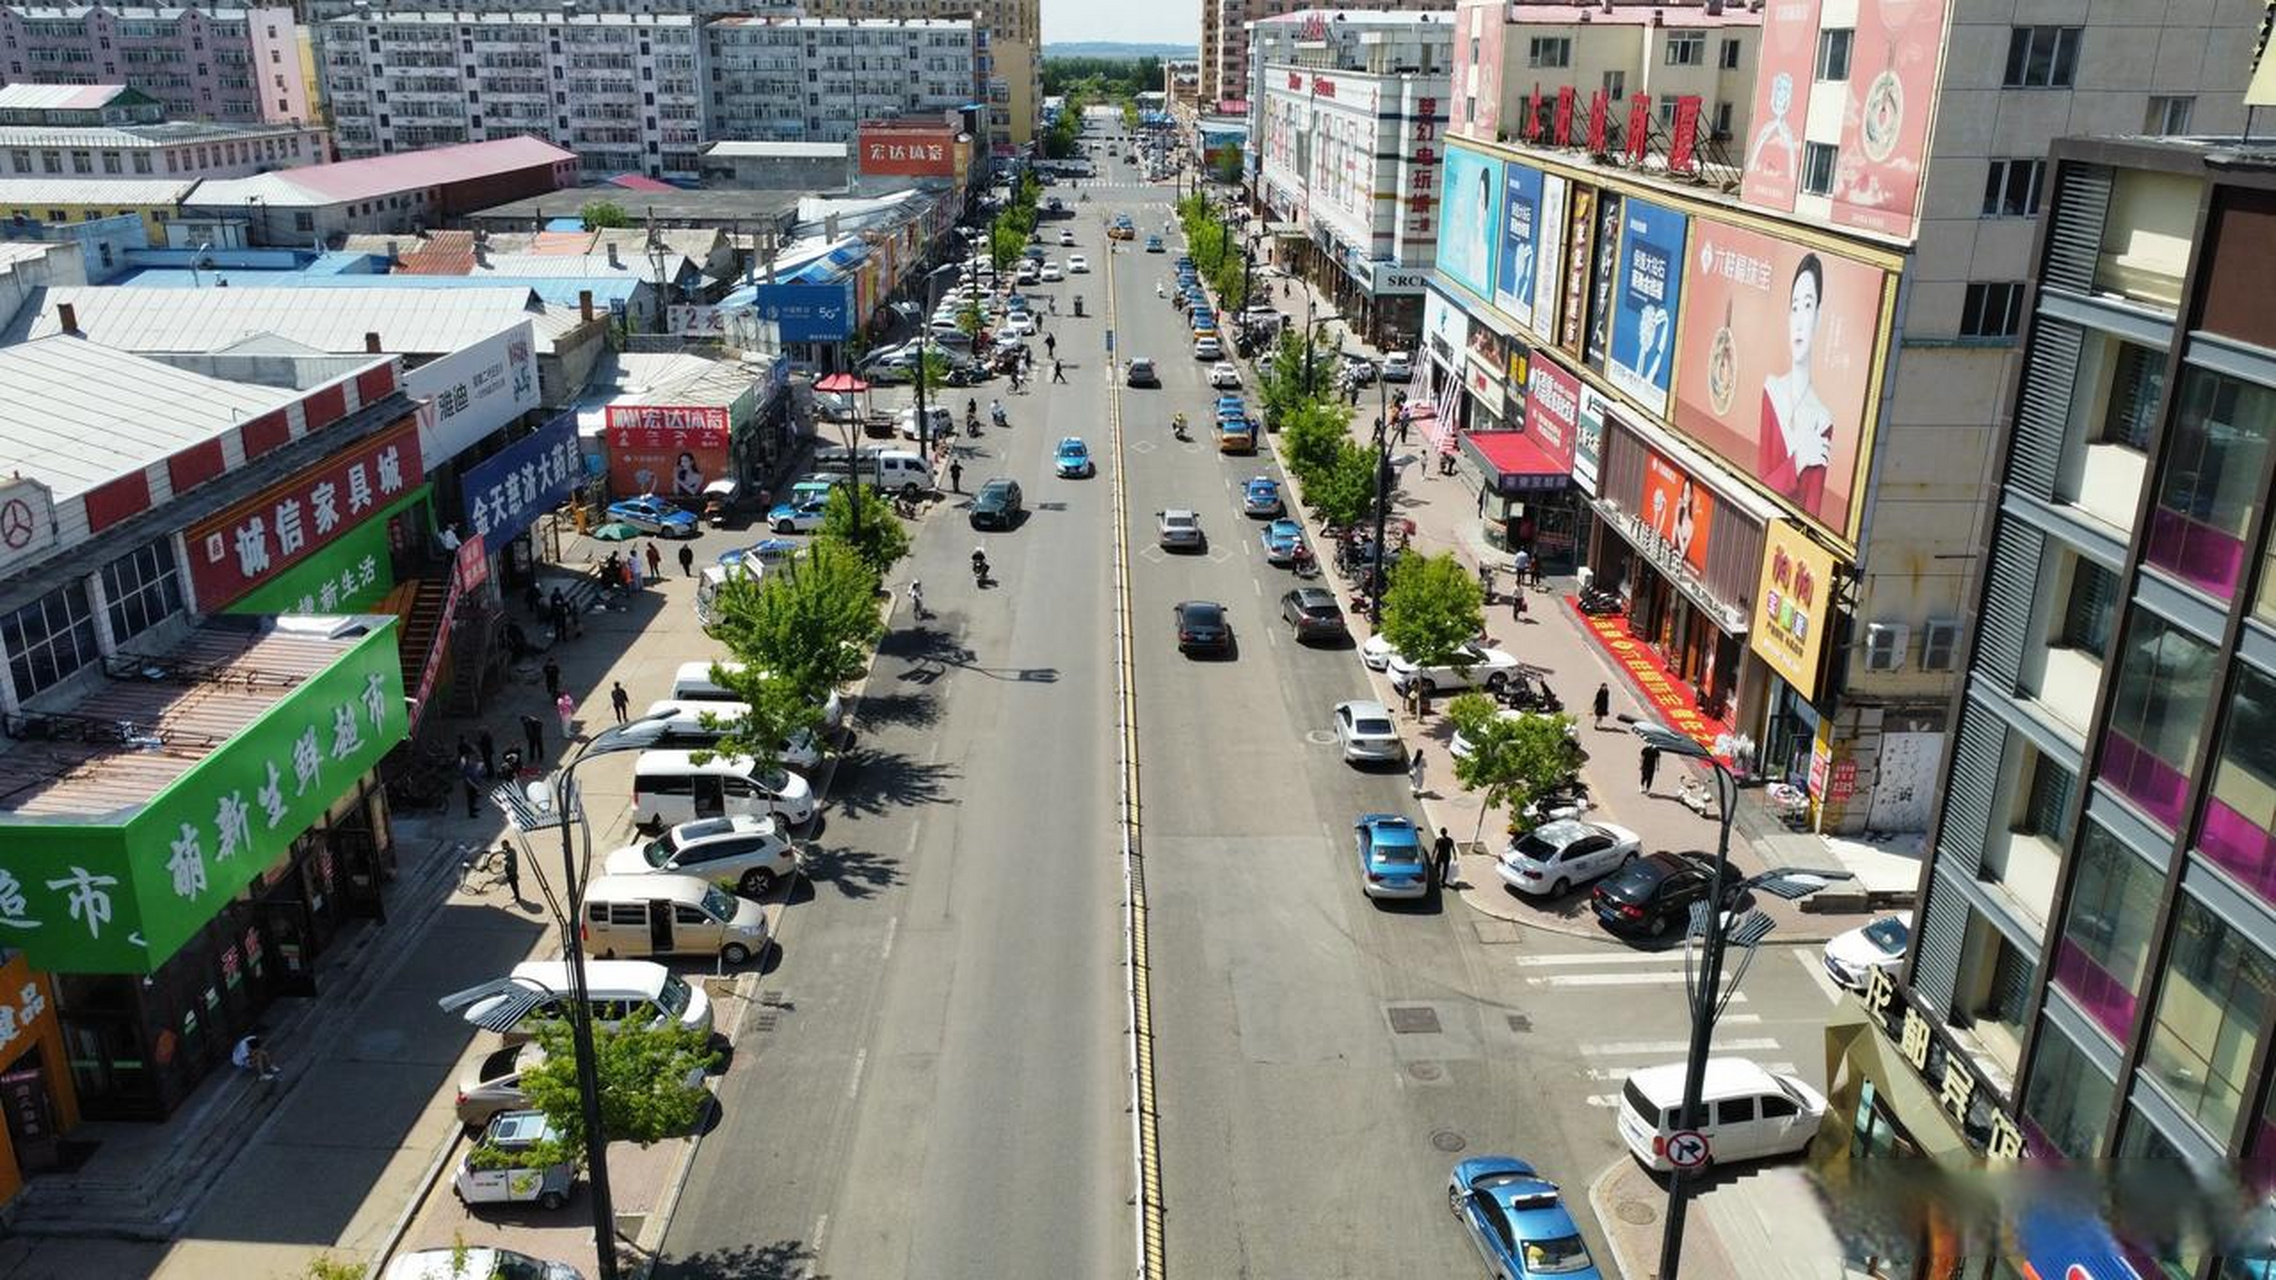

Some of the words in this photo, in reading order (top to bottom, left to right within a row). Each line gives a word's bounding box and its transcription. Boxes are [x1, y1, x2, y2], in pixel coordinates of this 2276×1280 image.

[234, 444, 404, 578] 诚信家具城
